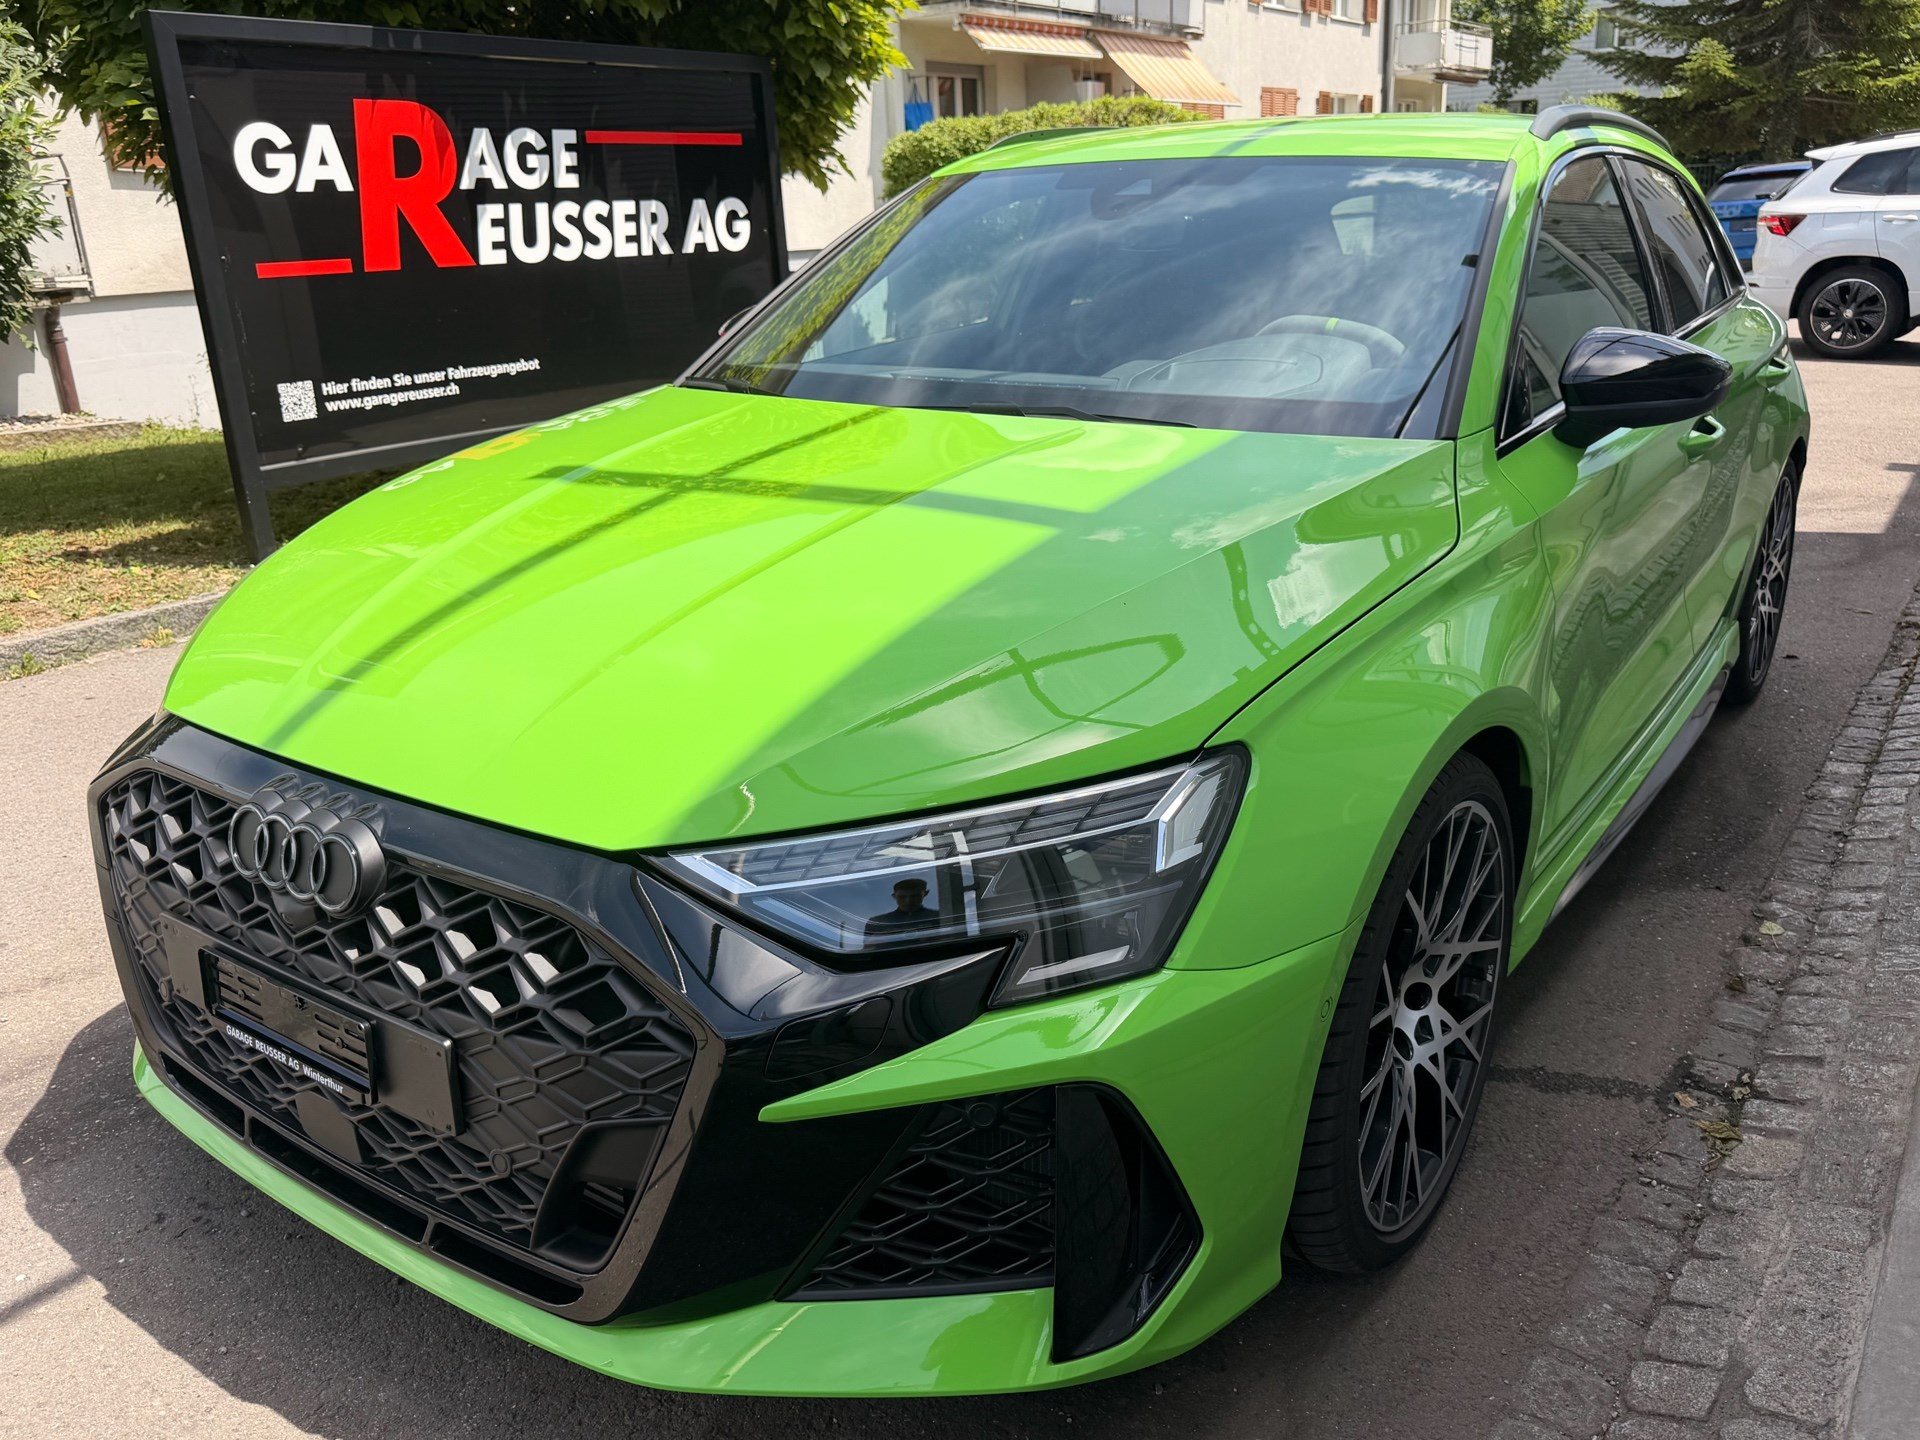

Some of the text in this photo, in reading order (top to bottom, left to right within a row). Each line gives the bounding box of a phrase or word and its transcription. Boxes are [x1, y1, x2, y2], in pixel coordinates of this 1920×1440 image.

[233, 99, 580, 272] GARAGE
[682, 197, 751, 253] AG
[320, 358, 541, 396] Hier finden Sie unser Fahrzeugangebot
[324, 382, 460, 412] www.garagereusser.ch
[226, 1024, 344, 1094] GARAGE REUSSER AG Winterthur
